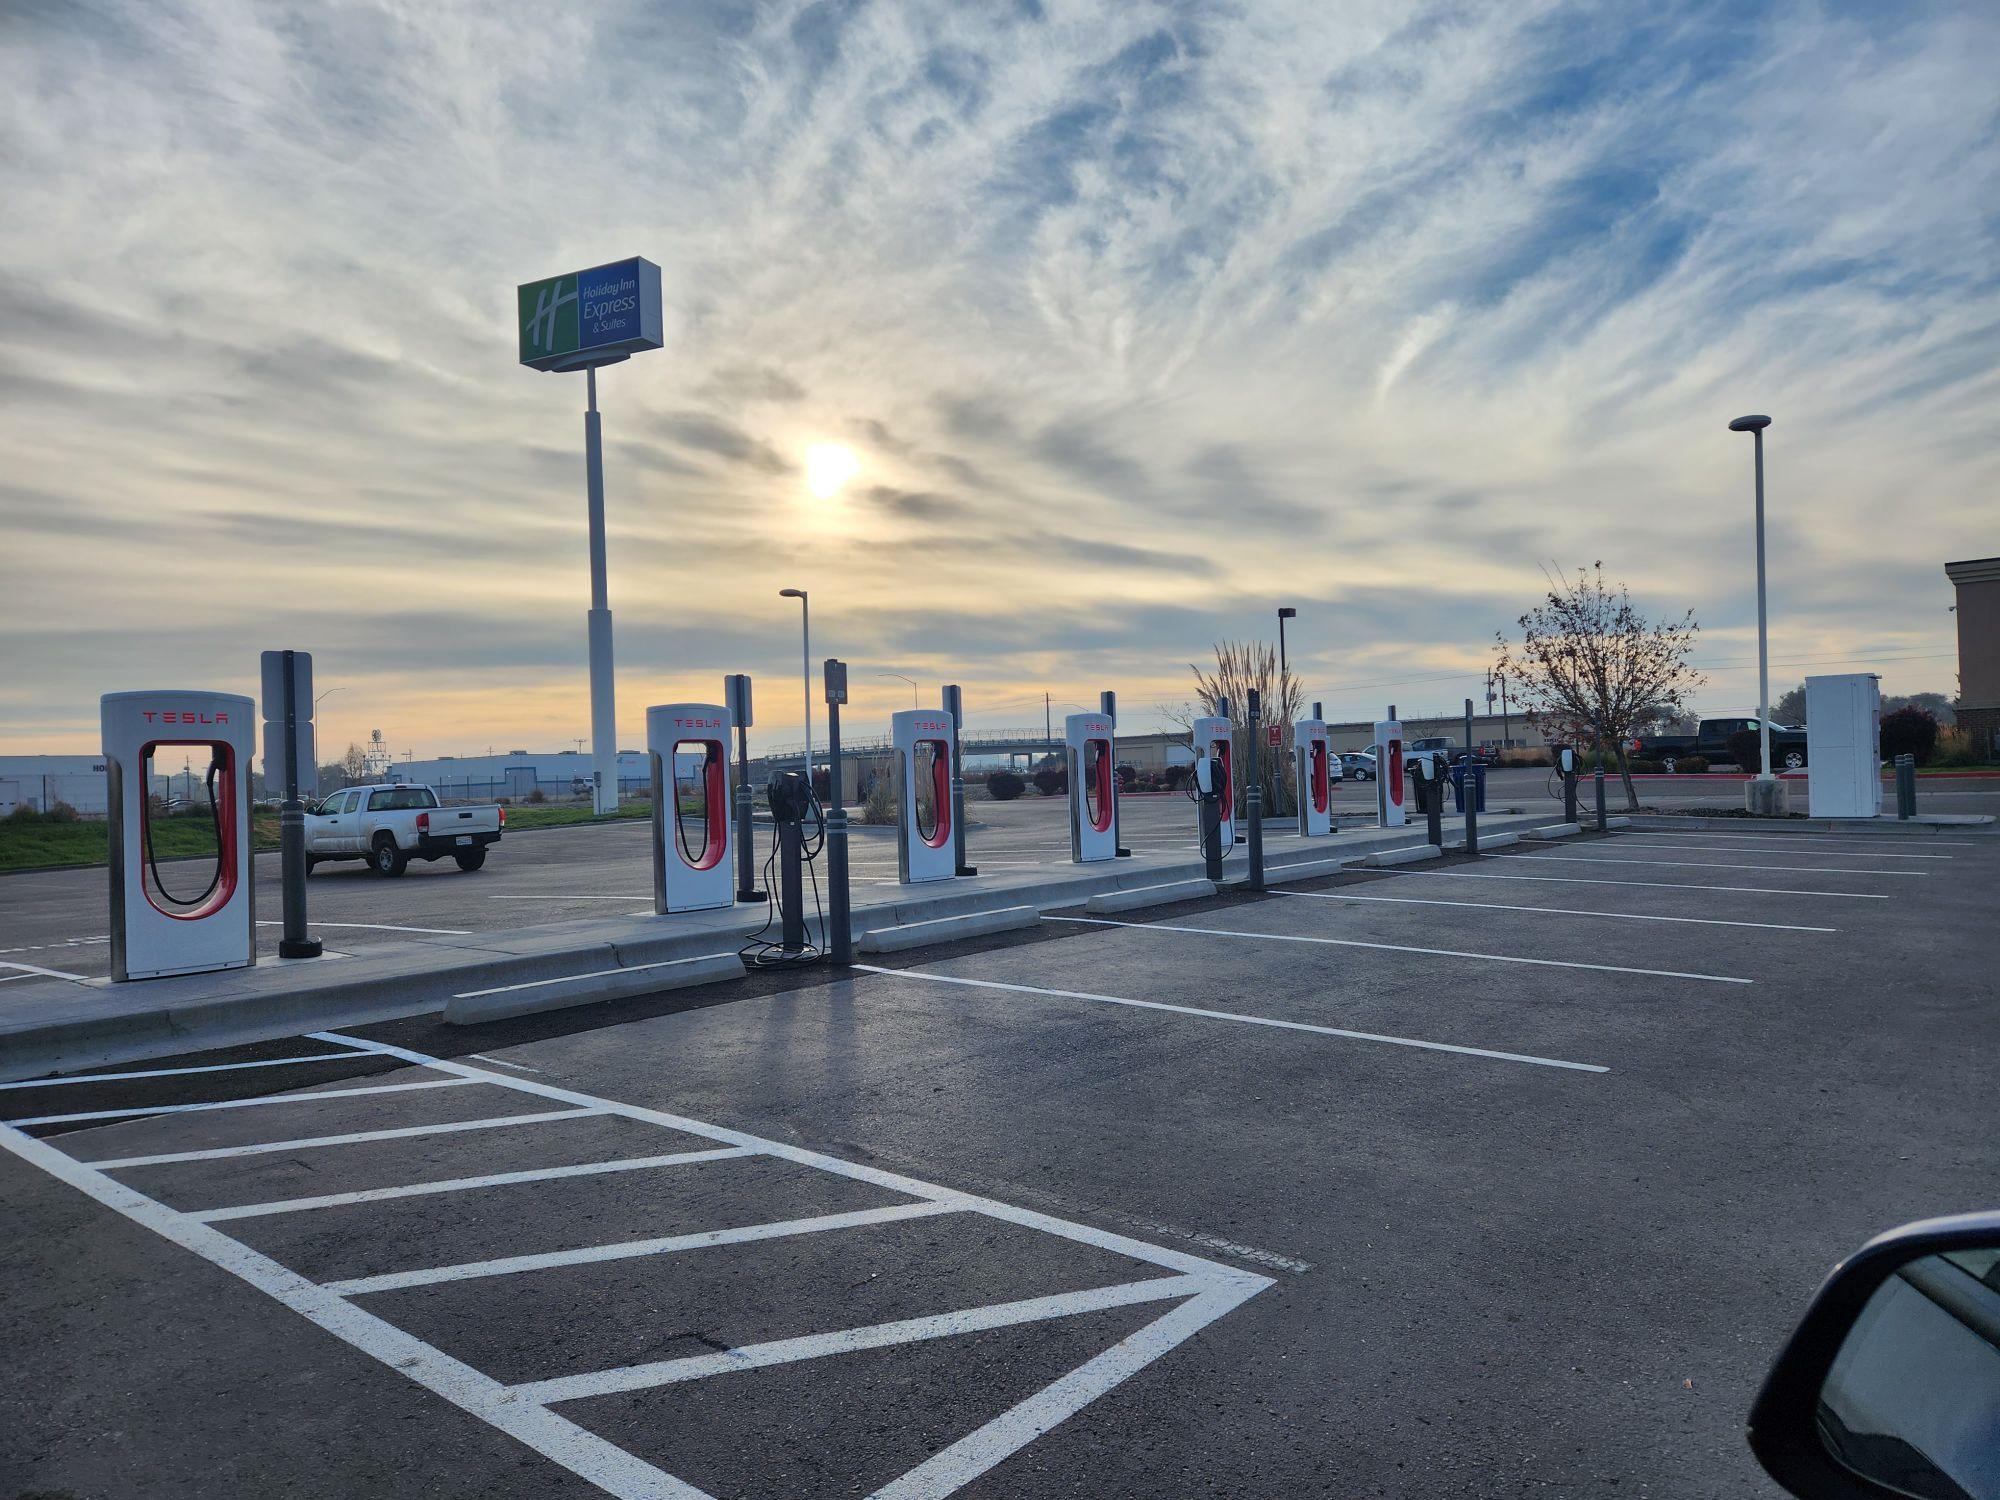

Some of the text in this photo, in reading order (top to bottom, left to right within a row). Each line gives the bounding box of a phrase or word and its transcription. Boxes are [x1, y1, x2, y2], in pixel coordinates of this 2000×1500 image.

[583, 278, 635, 299] Holiday Inn
[584, 295, 636, 320] Express
[593, 318, 626, 333] & Suites
[143, 711, 229, 724] TESLA
[675, 719, 721, 728] TESLA
[914, 722, 948, 731] TESLA
[92, 764, 108, 772] HO
